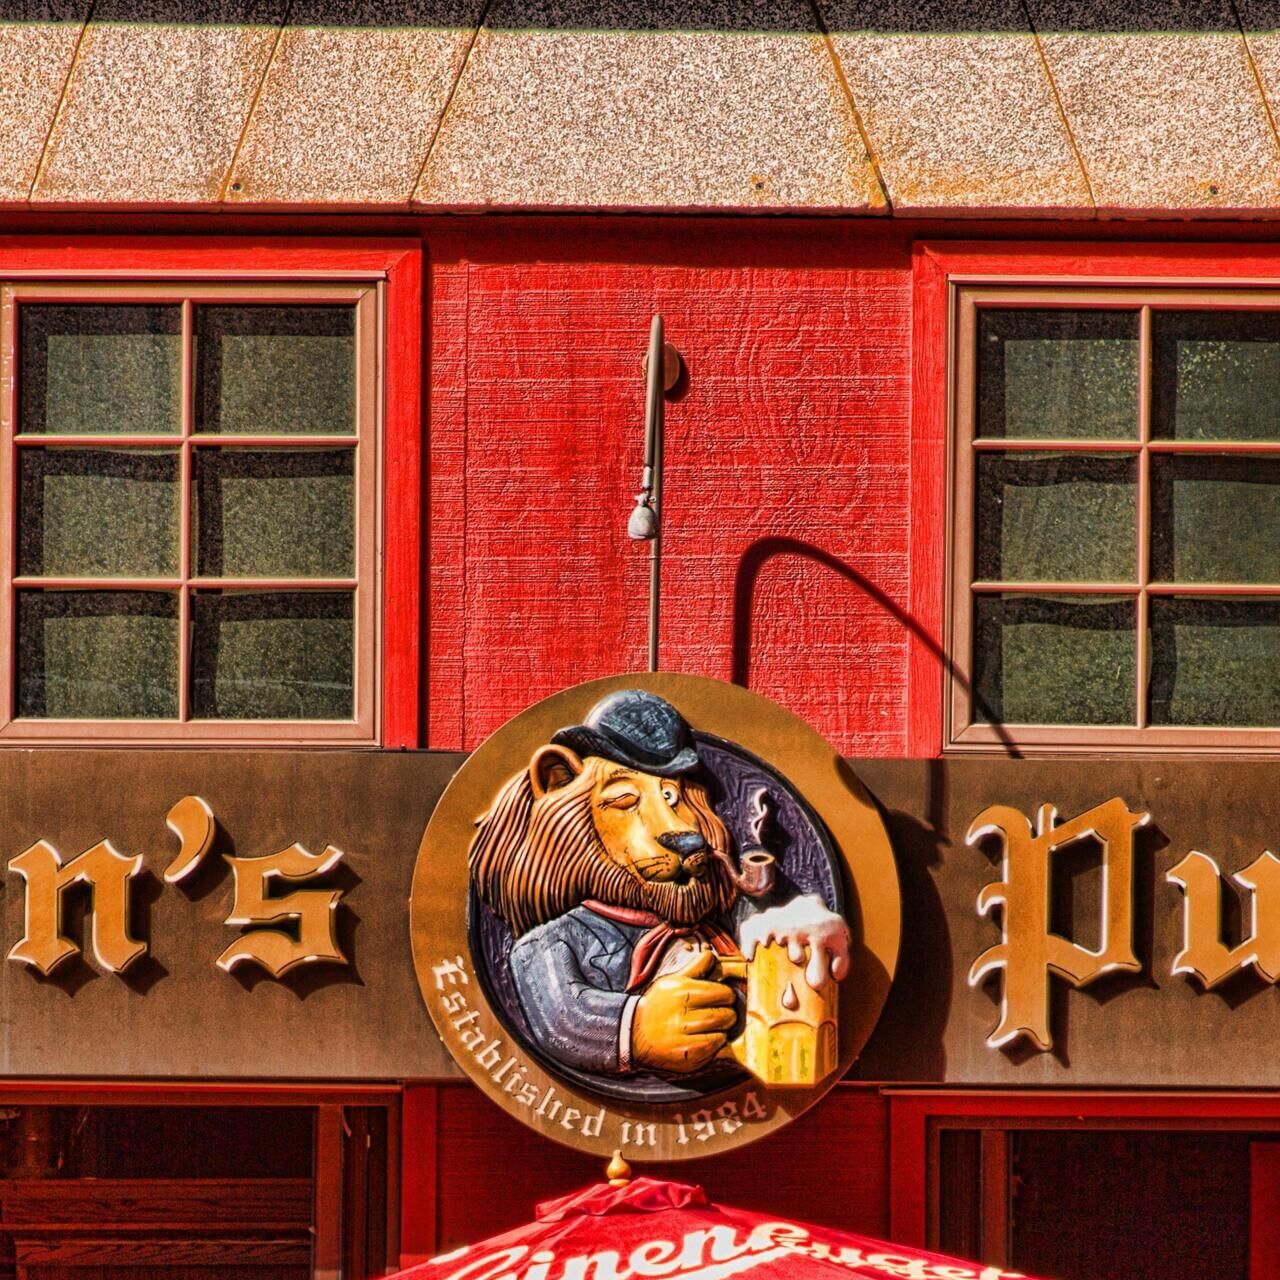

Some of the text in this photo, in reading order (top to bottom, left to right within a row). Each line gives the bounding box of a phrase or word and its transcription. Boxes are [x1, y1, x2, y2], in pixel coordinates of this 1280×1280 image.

[431, 953, 768, 1147] Established in 1984
